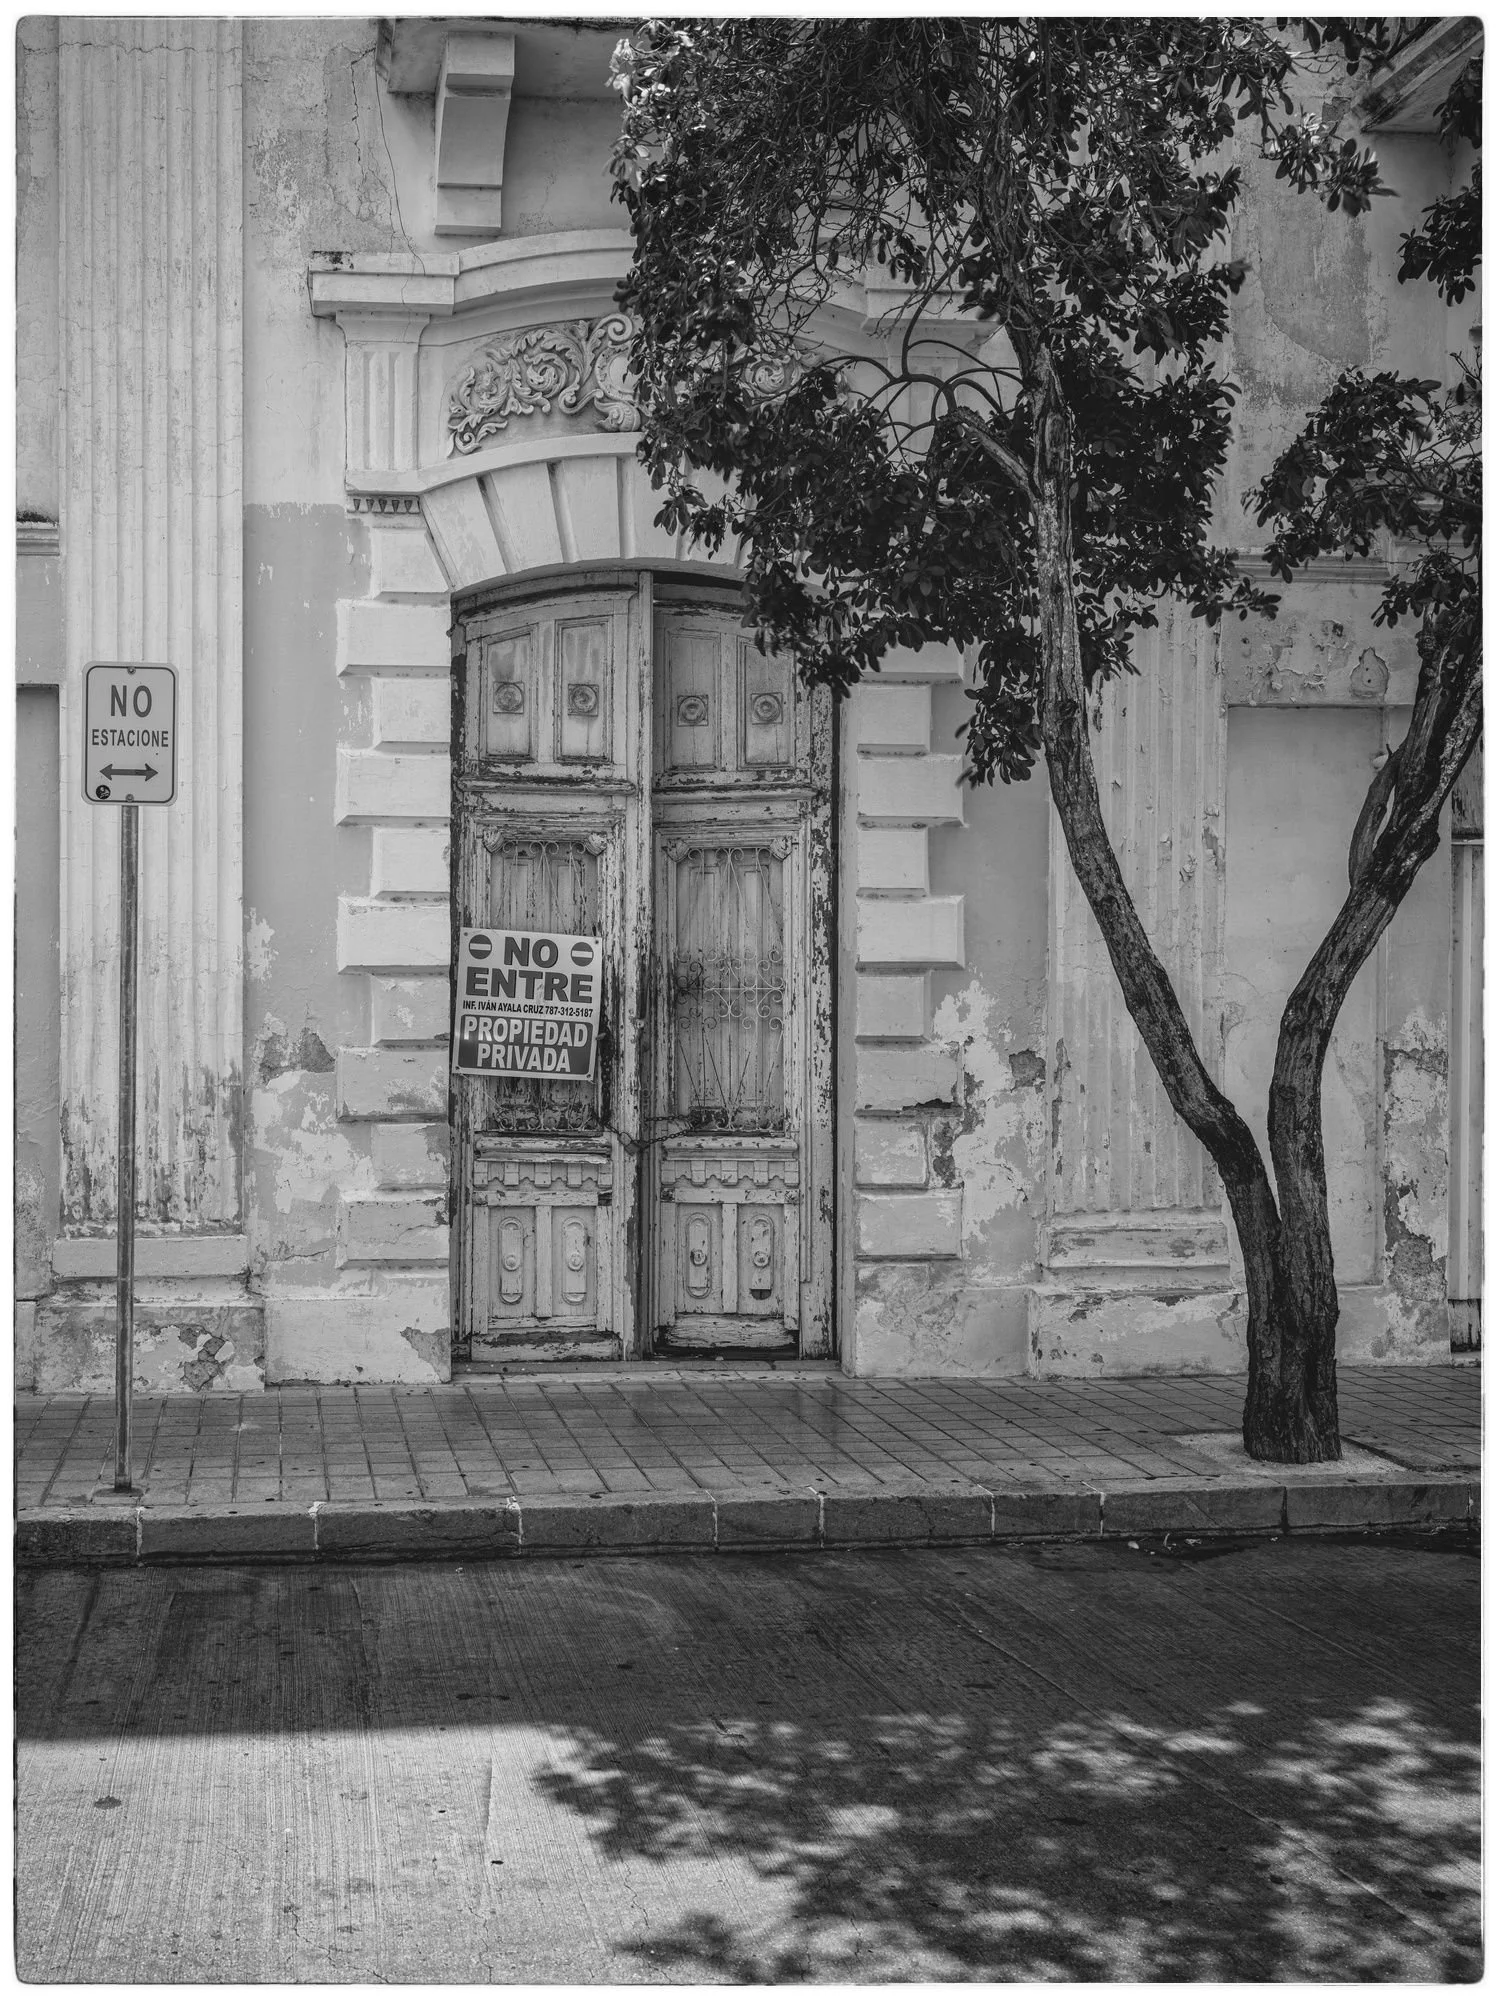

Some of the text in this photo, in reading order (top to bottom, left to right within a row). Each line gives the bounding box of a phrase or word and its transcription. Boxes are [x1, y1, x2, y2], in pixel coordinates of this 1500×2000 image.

[110, 684, 153, 718] NO
[91, 728, 169, 748] ESTACIONE
[503, 936, 559, 969] NO
[465, 966, 594, 1004] ENTRE
[462, 999, 593, 1018] INF. IVÁN AYALA CRUZ 787-312-5187
[463, 1015, 588, 1048] PROPIEDAD
[476, 1043, 571, 1073] PRIVADA
